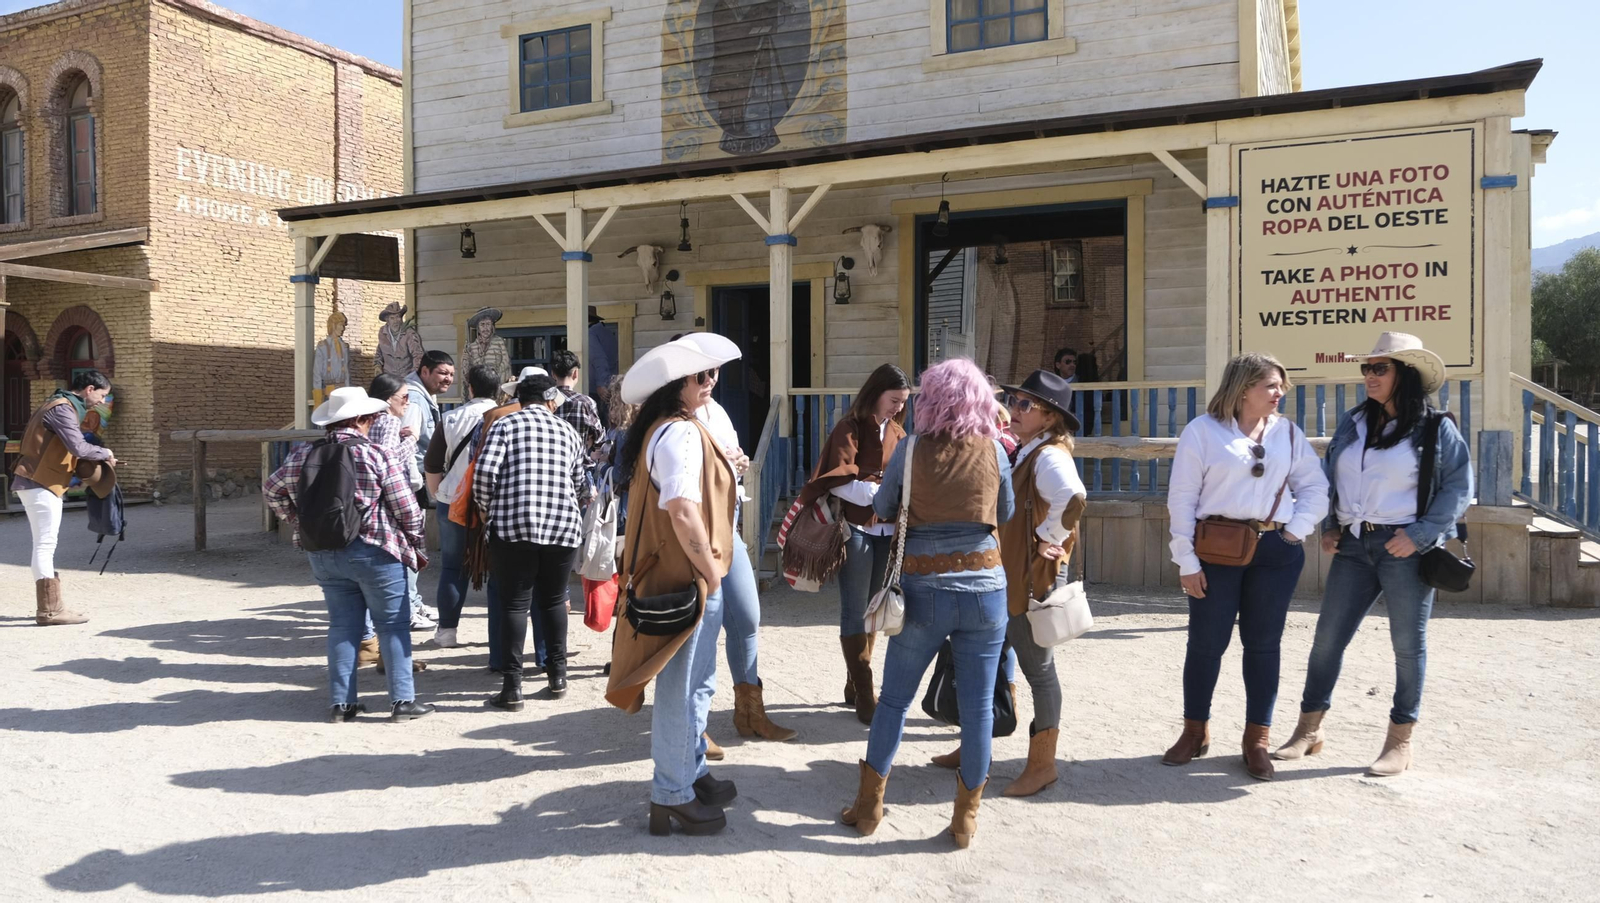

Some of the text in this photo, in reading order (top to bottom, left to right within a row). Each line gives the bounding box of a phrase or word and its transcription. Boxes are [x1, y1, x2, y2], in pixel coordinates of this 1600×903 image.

[175, 147, 402, 206] EVENING JOUR
[1261, 164, 1450, 194] HAZTE UNA FOTO
[175, 194, 190, 212] A
[195, 197, 253, 224] HOME
[256, 210, 270, 227] &
[1266, 187, 1444, 214] CON AUTÉNTICA
[1262, 208, 1449, 236] ROPA DEL OESTE
[1261, 261, 1448, 285] TAKE A PHOTO IN
[1290, 284, 1416, 305] AUTHENTIC
[1259, 305, 1451, 327] WESTERN ATTIRE
